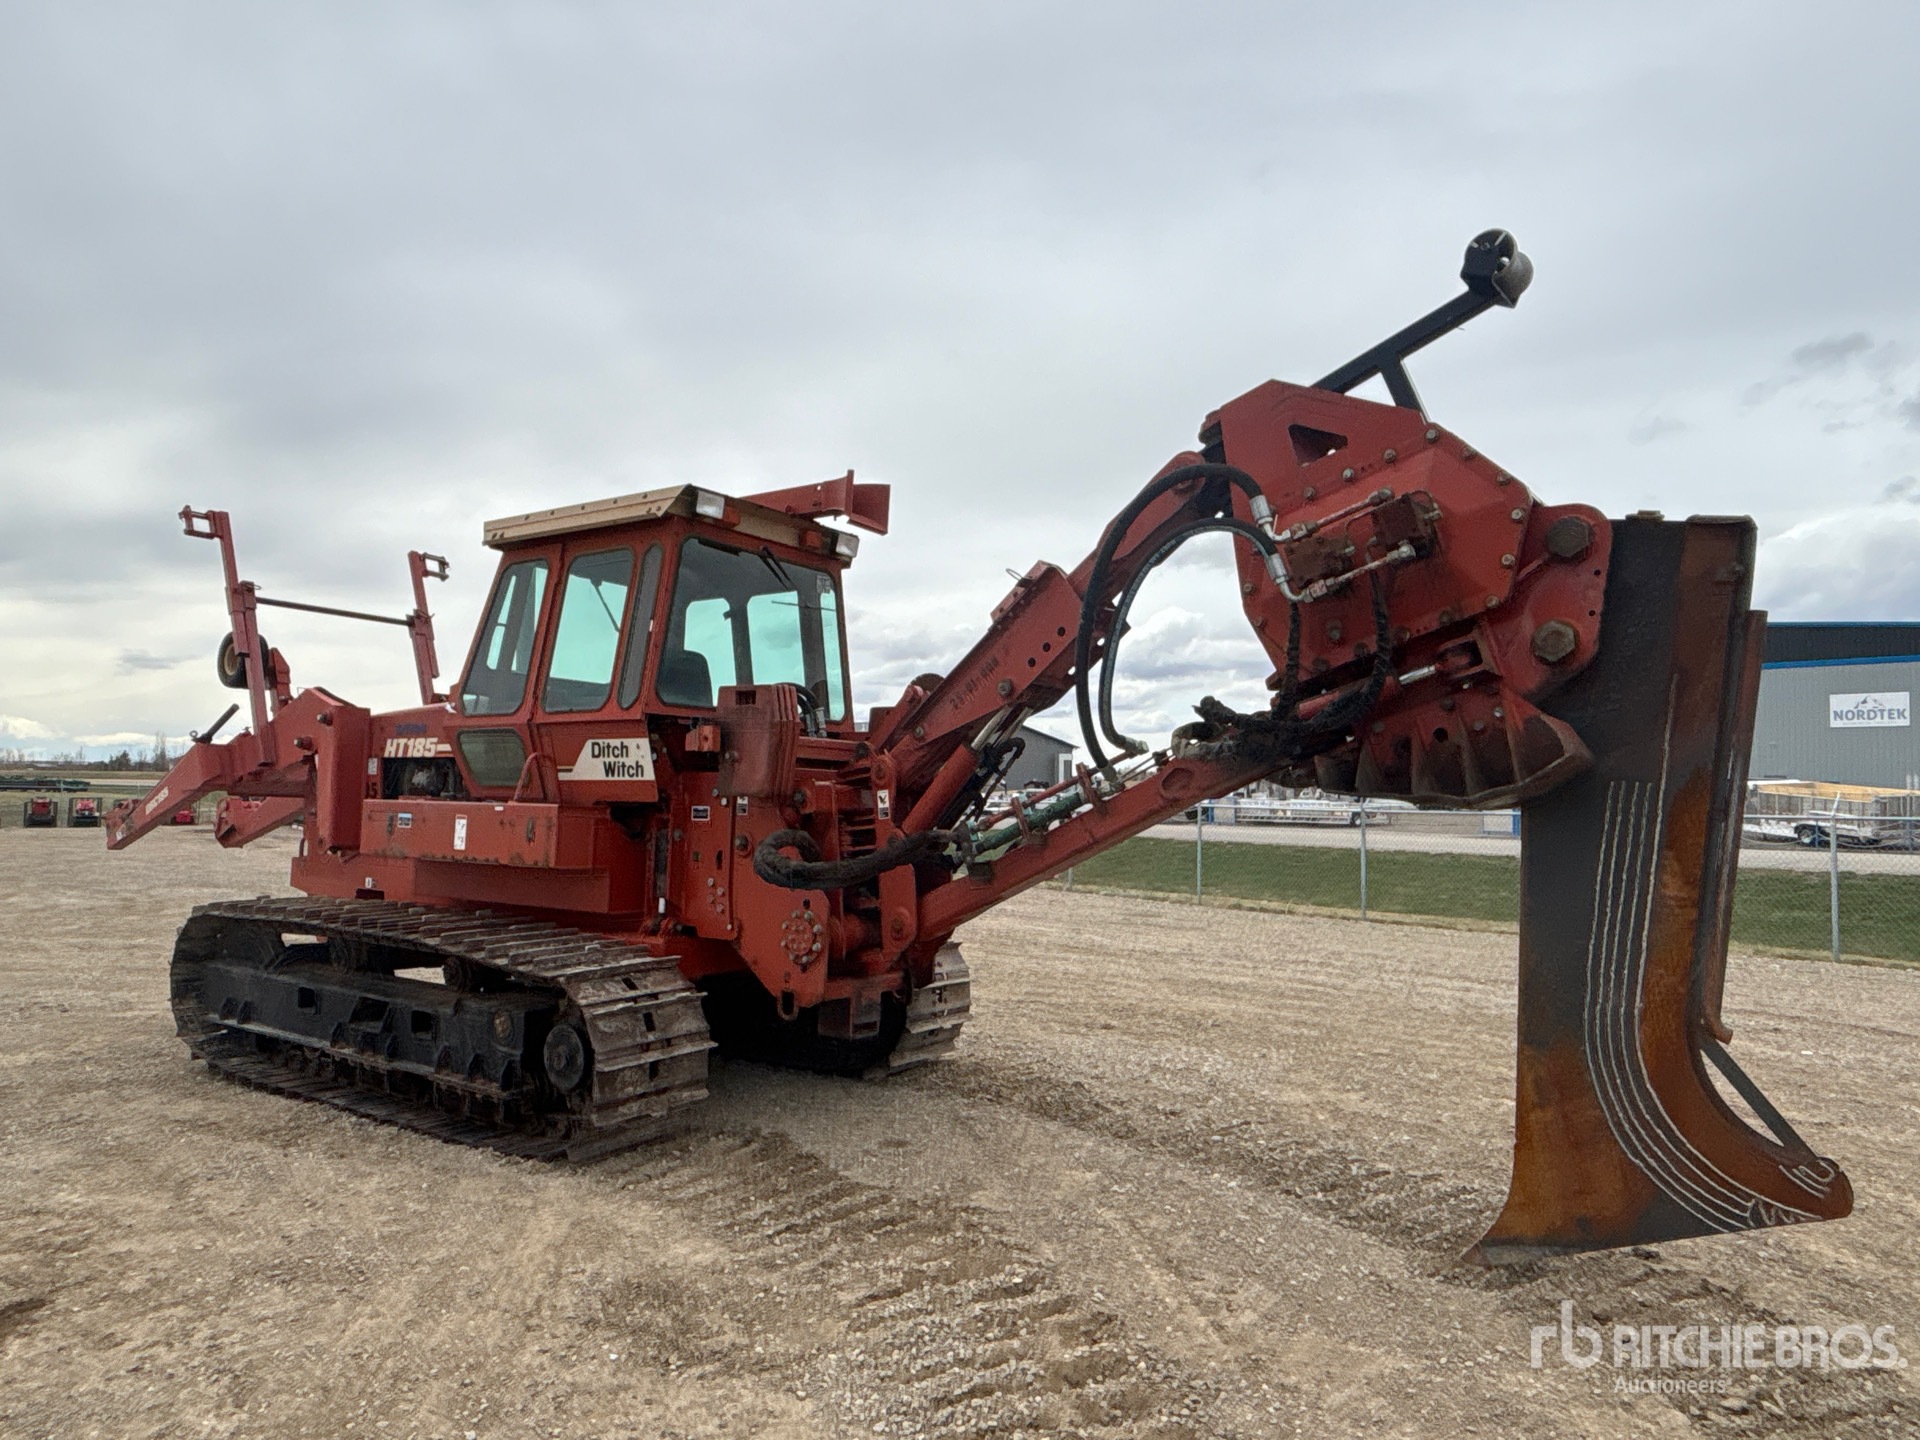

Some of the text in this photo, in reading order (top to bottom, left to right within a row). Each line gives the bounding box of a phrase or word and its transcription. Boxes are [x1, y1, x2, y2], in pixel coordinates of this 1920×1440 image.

[1833, 708, 1907, 721] NORDTEK
[383, 737, 439, 758] HT185
[591, 741, 629, 759] Ditch
[603, 761, 645, 778] Witch
